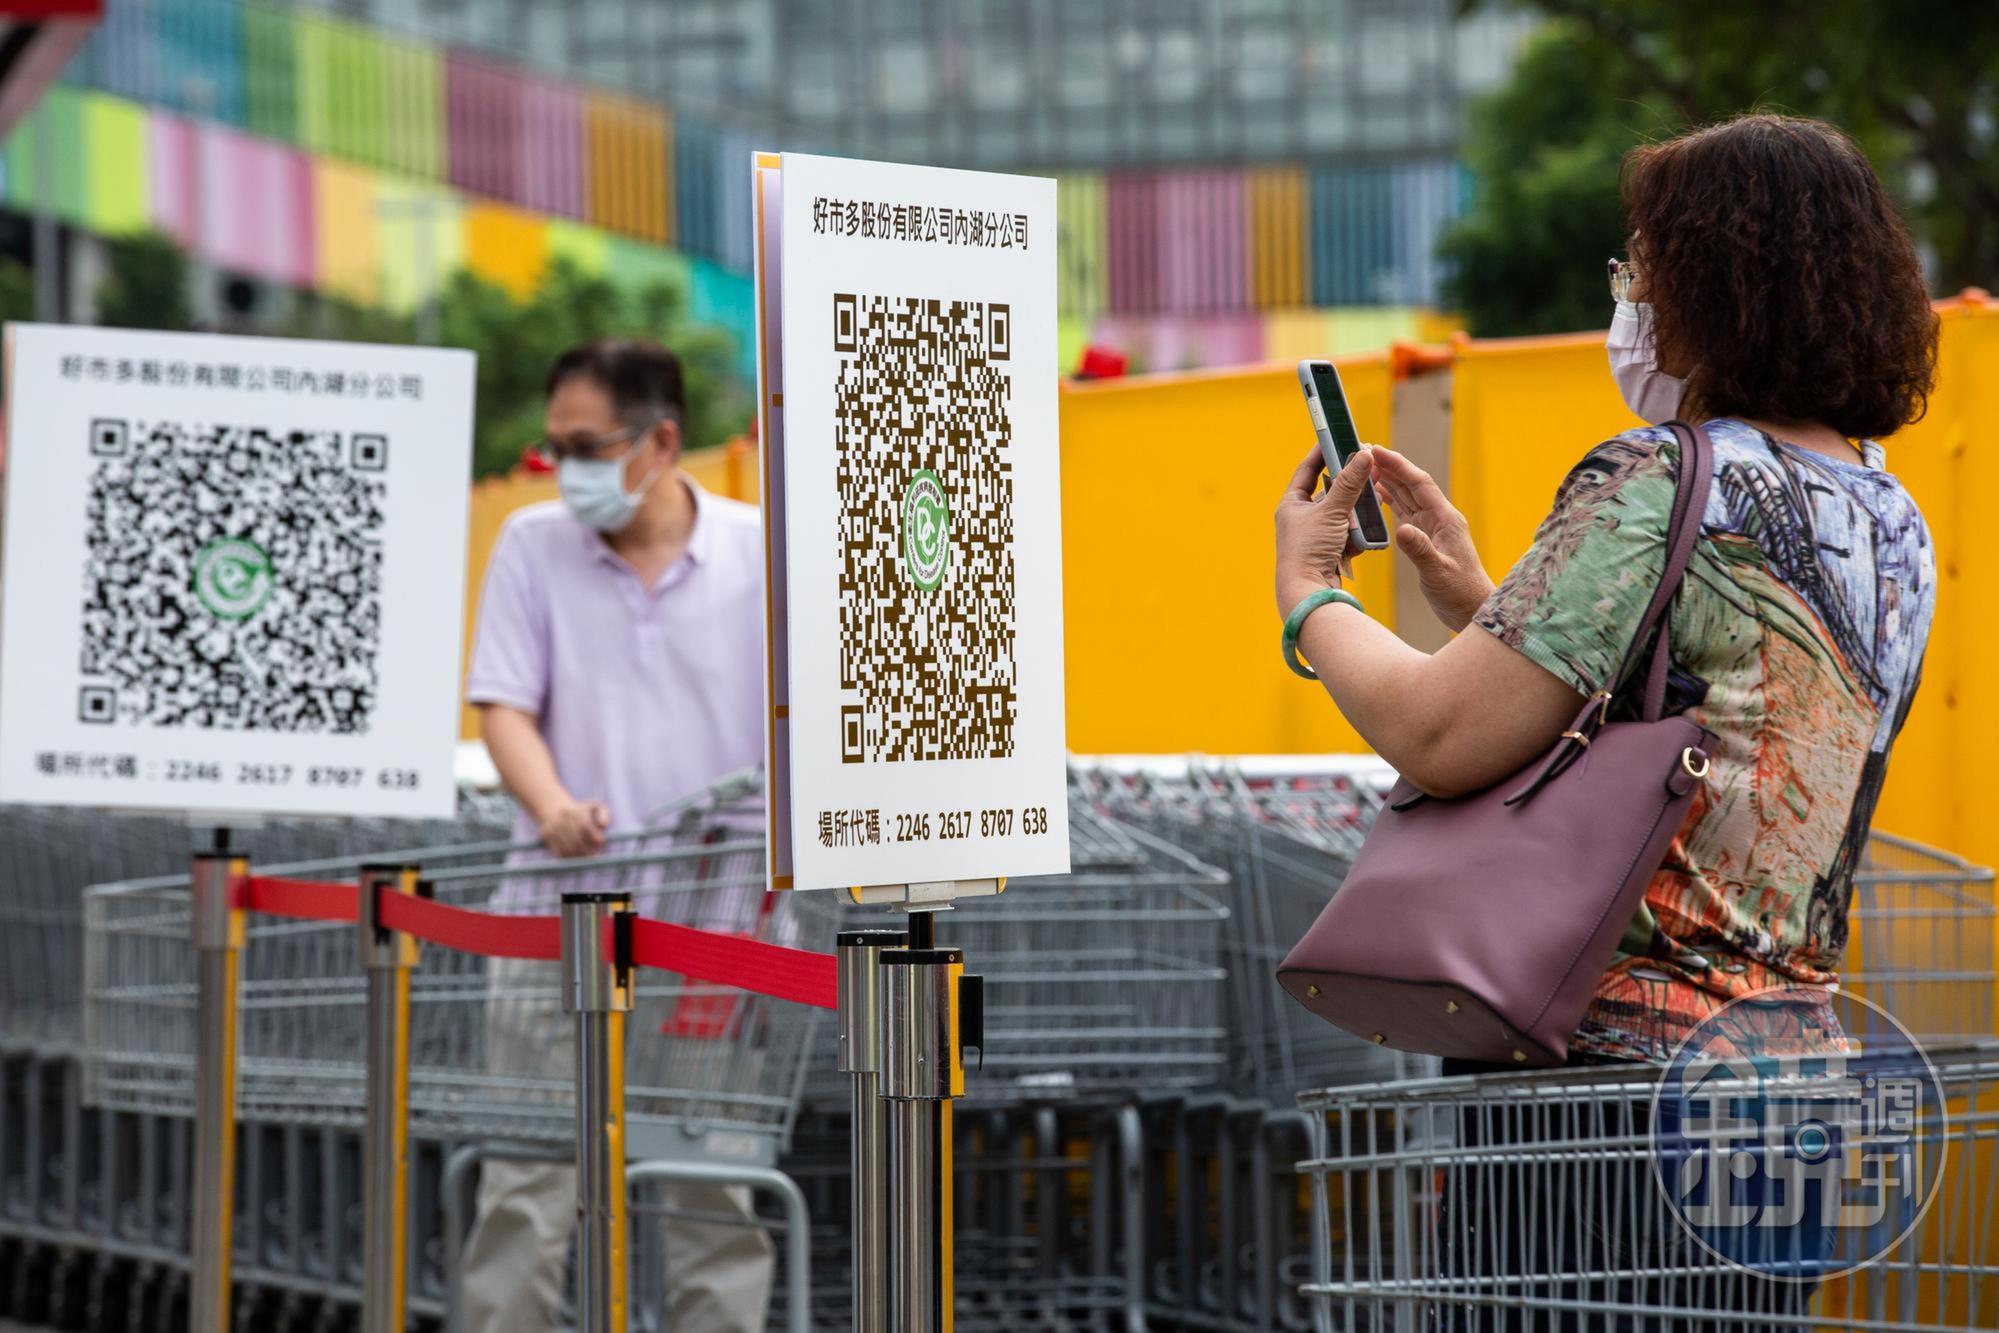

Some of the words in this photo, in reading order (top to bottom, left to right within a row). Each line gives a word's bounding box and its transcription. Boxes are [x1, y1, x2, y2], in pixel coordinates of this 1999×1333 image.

[938, 811, 972, 840] 2617
[981, 809, 1014, 838] 8707
[1022, 807, 1048, 835] 638
